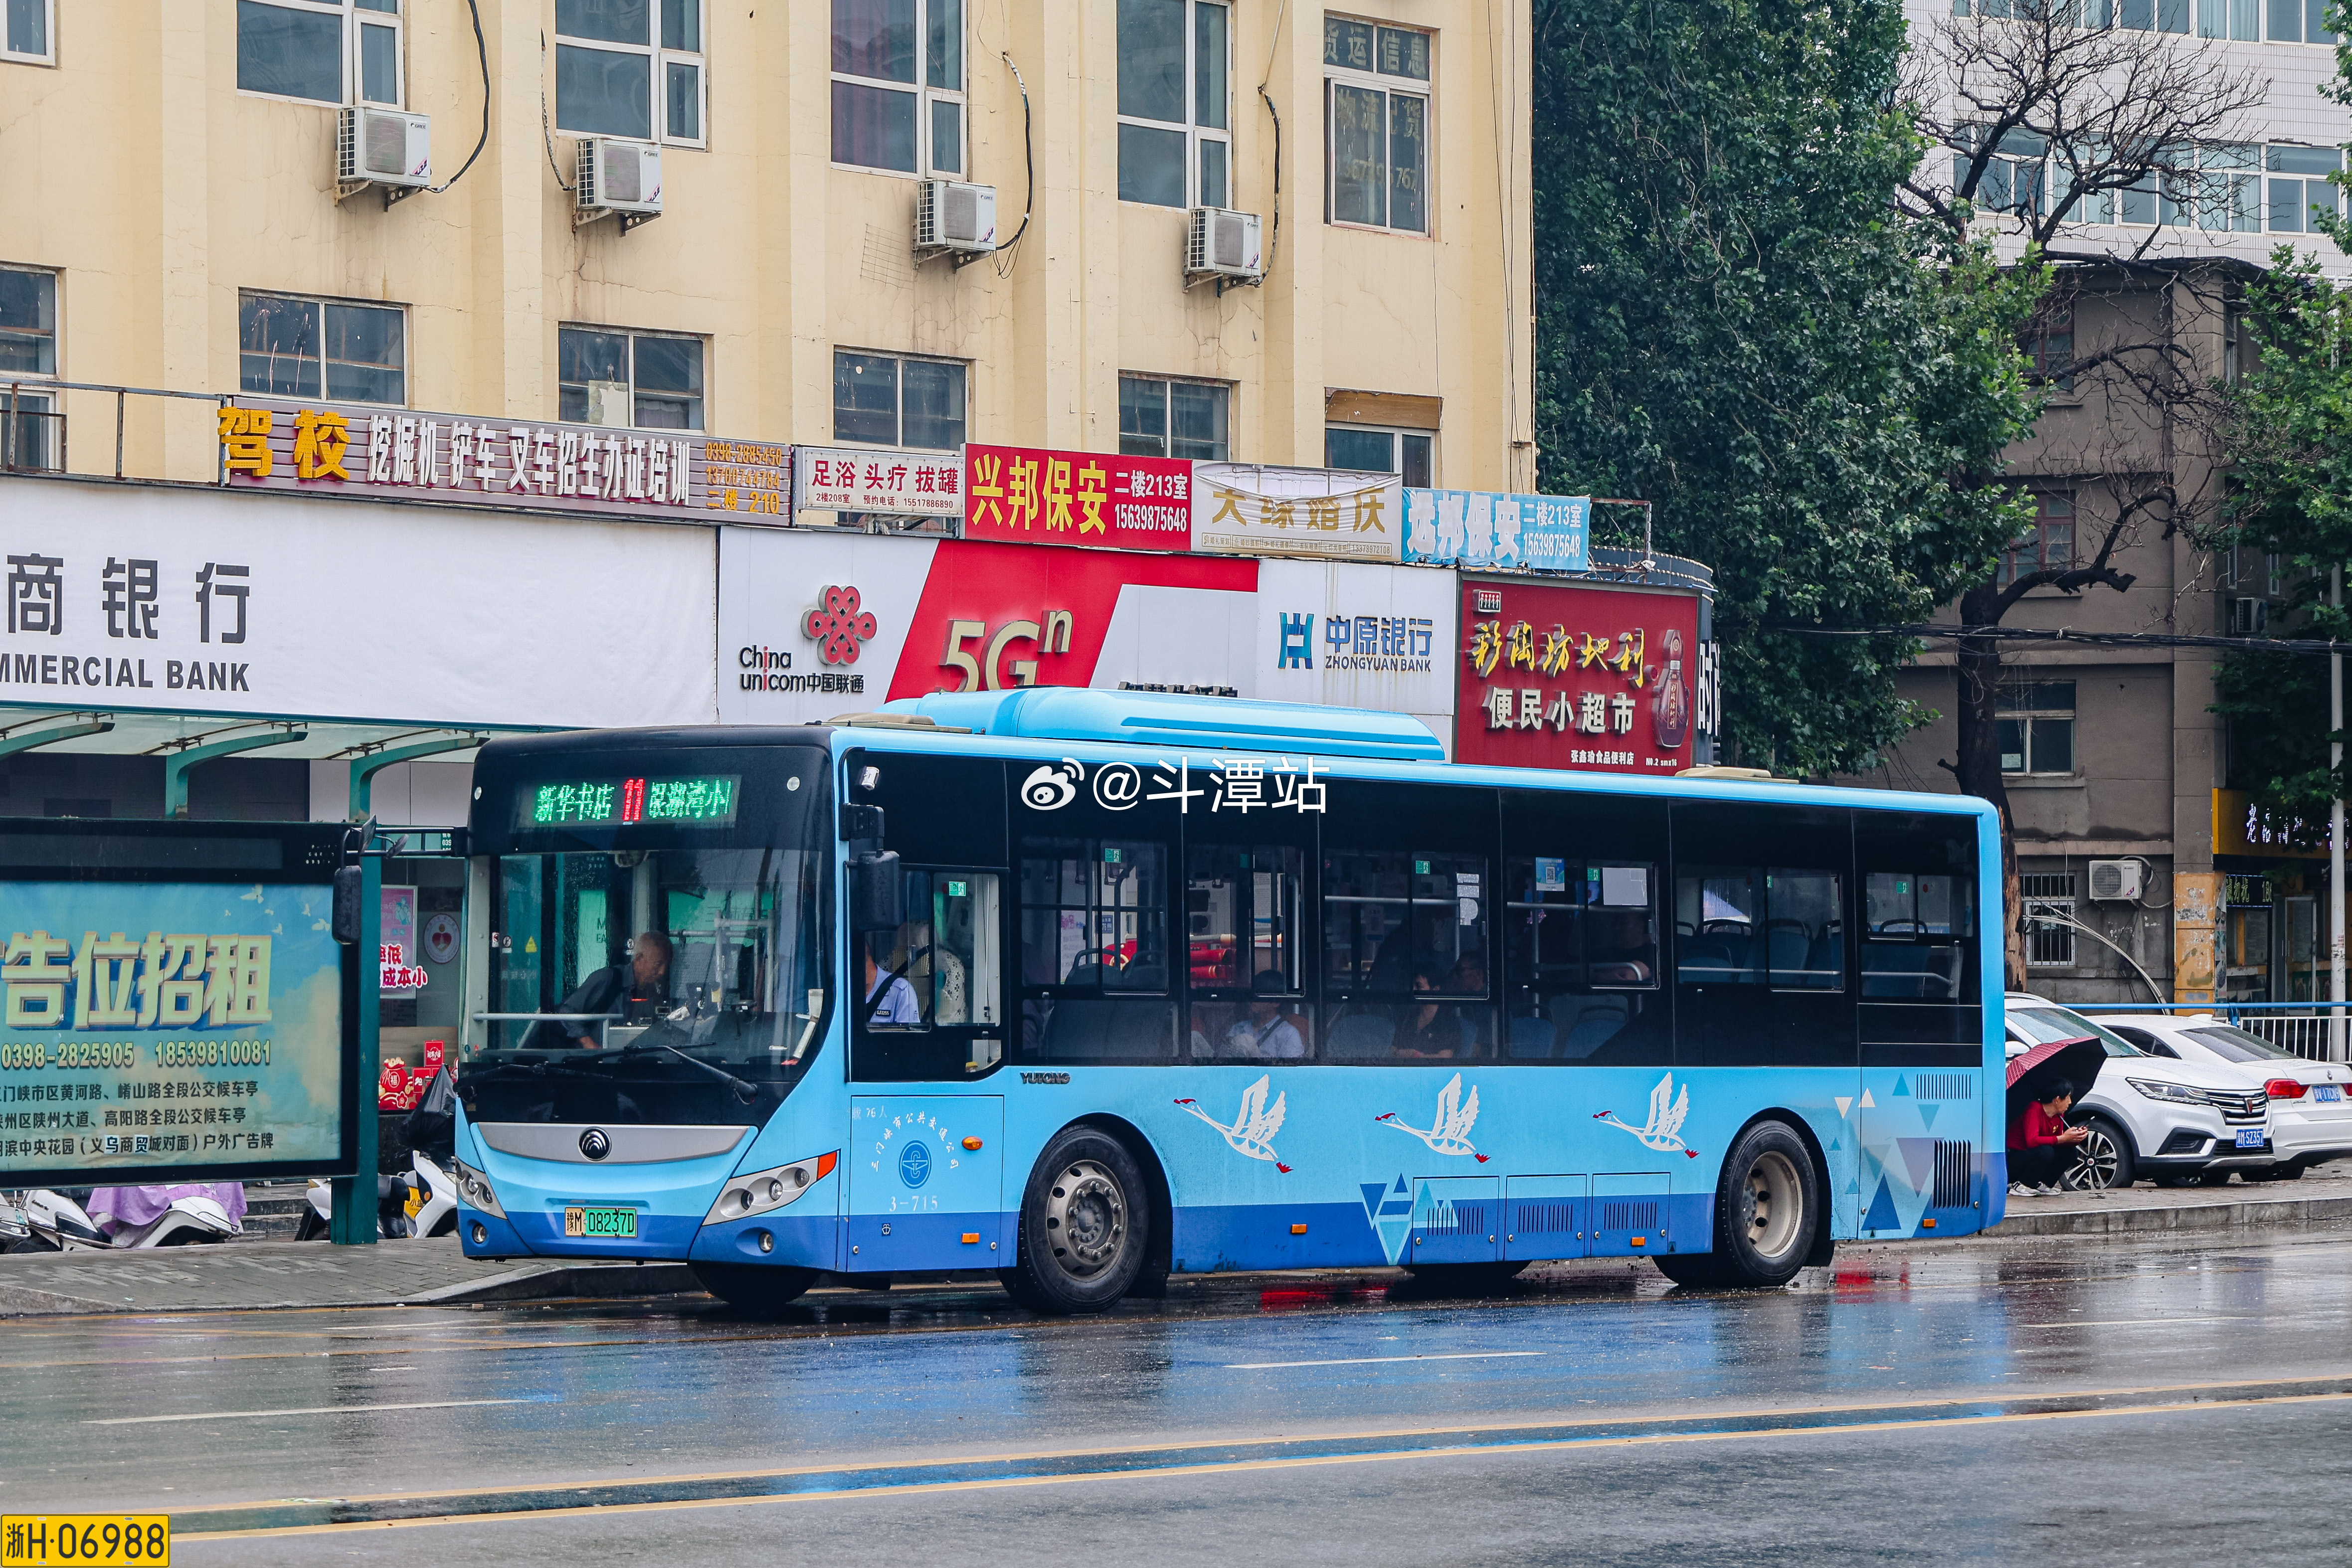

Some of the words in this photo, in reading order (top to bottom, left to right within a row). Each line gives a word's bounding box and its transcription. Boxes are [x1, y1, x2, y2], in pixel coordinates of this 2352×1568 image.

[217, 406, 351, 480] 驾校
[706, 442, 782, 466] 0398-2885450
[367, 414, 438, 485] 挖掘机
[450, 421, 497, 491] 铲车
[508, 426, 690, 506] 叉车招生办证培训
[706, 466, 780, 490] 13700744784
[812, 460, 856, 489] 足浴
[864, 463, 907, 492] 头疗
[915, 466, 959, 495] 拔罐
[1114, 469, 1188, 501] 二楼213室
[707, 489, 738, 511] 二楼
[749, 491, 780, 514] 210
[816, 492, 850, 504] 2楼208室
[904, 498, 953, 509] 15517886890
[972, 453, 1107, 535] 兴邦保安
[1114, 503, 1187, 532] 15639875648
[1523, 501, 1583, 528] 二楼213室
[1352, 544, 1390, 554] 13373972108
[1523, 532, 1580, 558] 15639875648
[6, 552, 251, 645] 商银行
[1325, 615, 1433, 656] 中原银行
[739, 644, 792, 669] China
[1325, 656, 1398, 671] ZHONGYUAN
[1400, 658, 1432, 672] BANK
[167, 660, 250, 693] BANK
[739, 669, 806, 692] unicom
[806, 673, 865, 693] 中国联通
[1483, 686, 1636, 735] 便民小超市
[1571, 749, 1634, 765] 张鑫瑜食品便利店
[535, 781, 615, 822] 新华书店
[622, 778, 645, 822] 11
[0, 930, 272, 1031] 告位招租
[1, 1042, 135, 1068] 0398-2825905
[155, 1040, 271, 1067] 18539810081
[1020, 1071, 1071, 1084] YUTONG
[889, 1195, 938, 1212] 3-715
